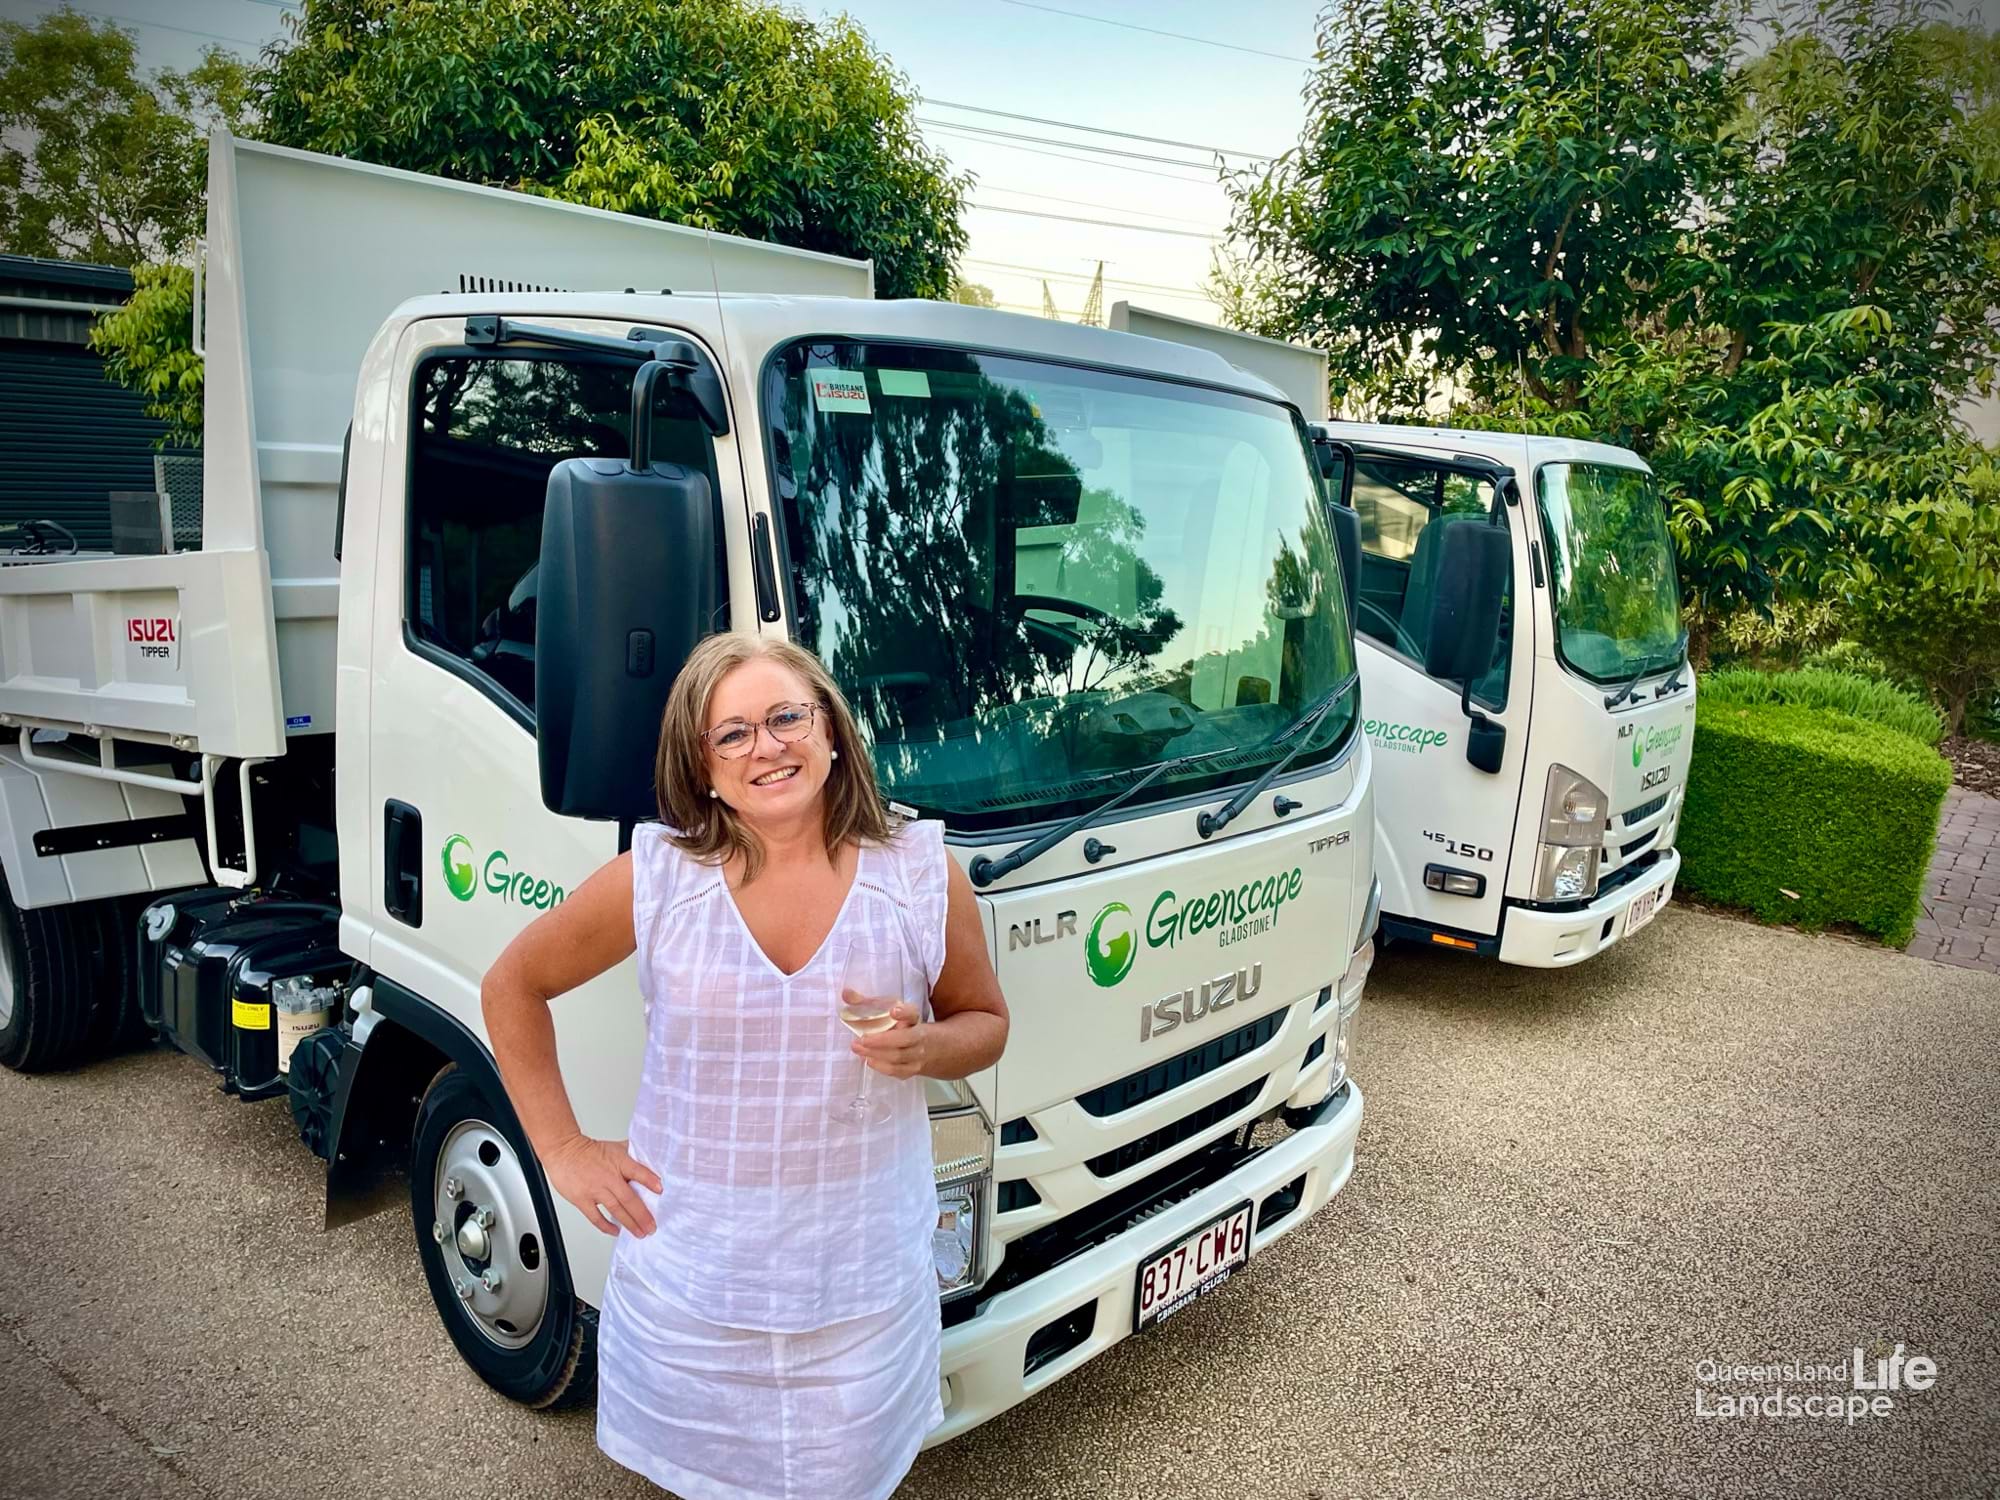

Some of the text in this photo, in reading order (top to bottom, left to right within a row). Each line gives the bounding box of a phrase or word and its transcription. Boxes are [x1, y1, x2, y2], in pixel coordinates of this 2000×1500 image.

[829, 383, 864, 392] BRISBANE
[831, 391, 866, 400] ISUZU
[140, 646, 169, 658] TIPPER
[1362, 719, 1448, 753] enscape
[1618, 723, 1634, 739] NLR
[1374, 739, 1416, 754] GLADSTONE
[1640, 765, 1671, 792] ISUZU
[1307, 830, 1350, 855] TIPPER
[1423, 830, 1493, 861] 45 150
[483, 849, 573, 910] Green
[1145, 867, 1303, 949] Greenscape
[1008, 909, 1078, 951] NLR
[1219, 914, 1271, 948] GLADSTONE
[1140, 961, 1262, 1043] ISUZU
[292, 1023, 320, 1031] ISUZU
[1200, 1269, 1231, 1295] ISUZU
